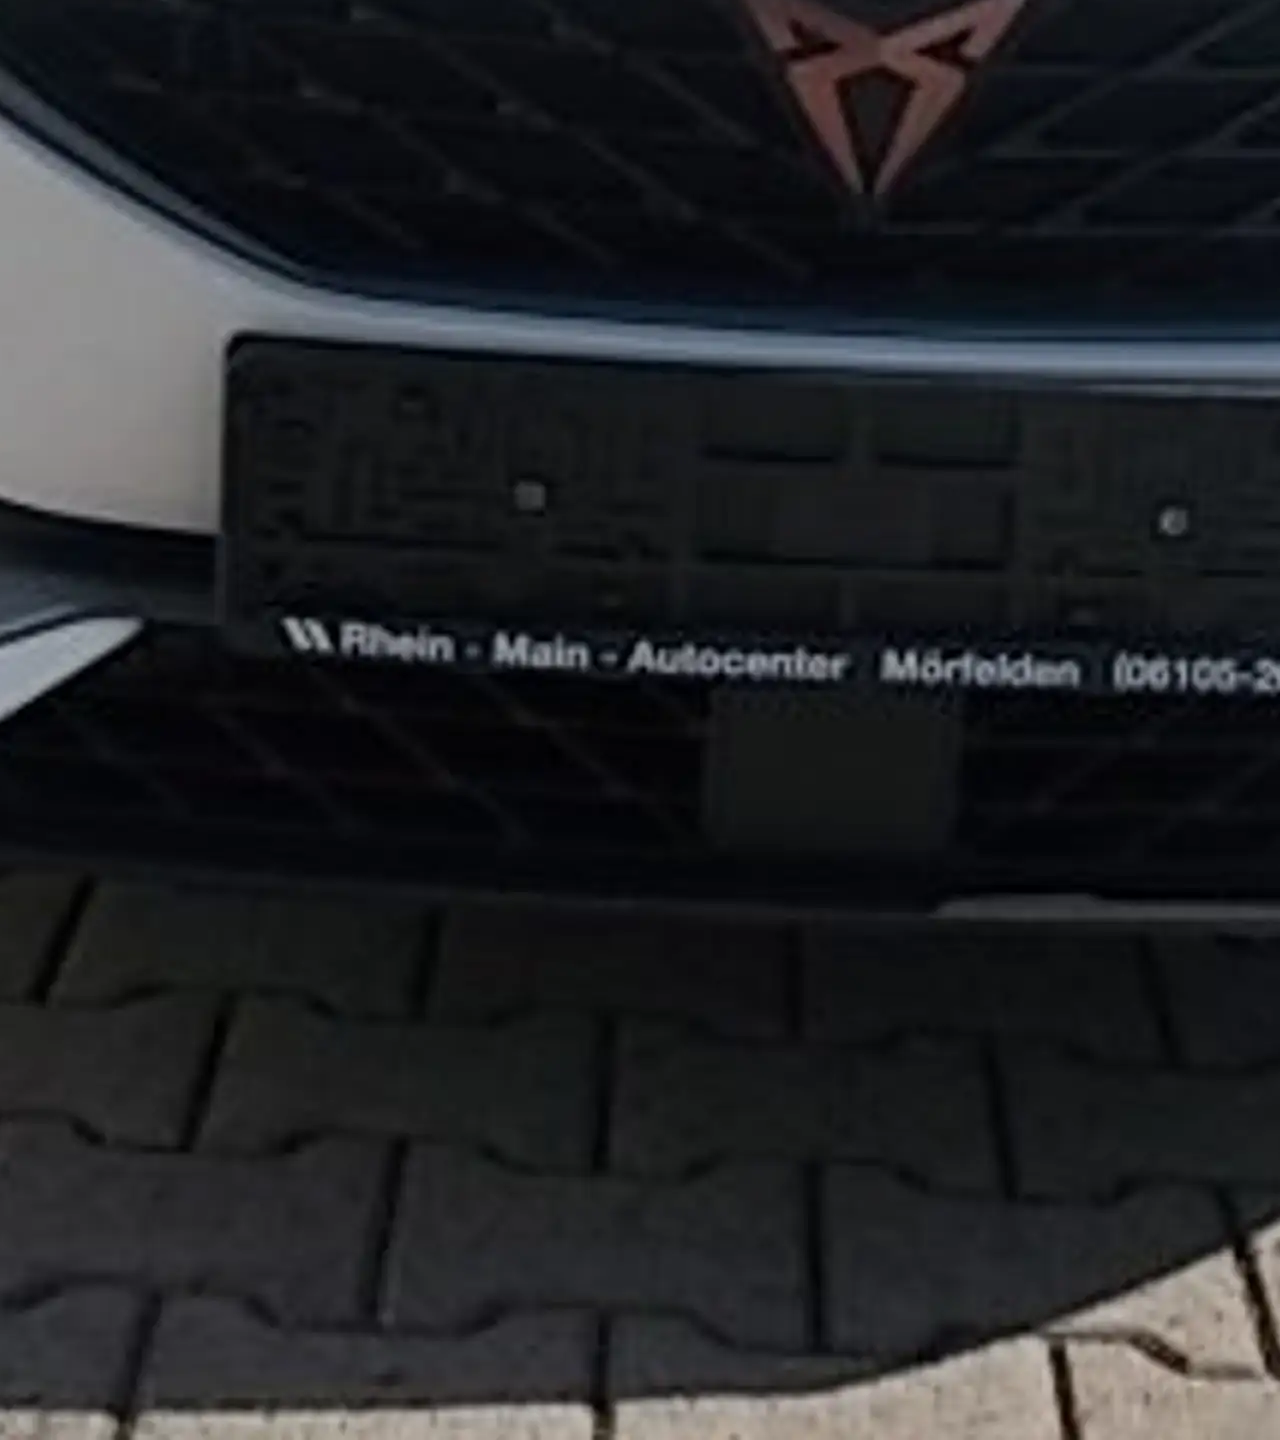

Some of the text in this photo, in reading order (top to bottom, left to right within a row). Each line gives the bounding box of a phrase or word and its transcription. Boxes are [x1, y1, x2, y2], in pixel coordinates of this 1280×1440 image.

[338, 620, 454, 662] Rhein
[492, 630, 590, 670] Main
[627, 639, 850, 681] Autocenter
[879, 648, 1081, 690] Mörfelden
